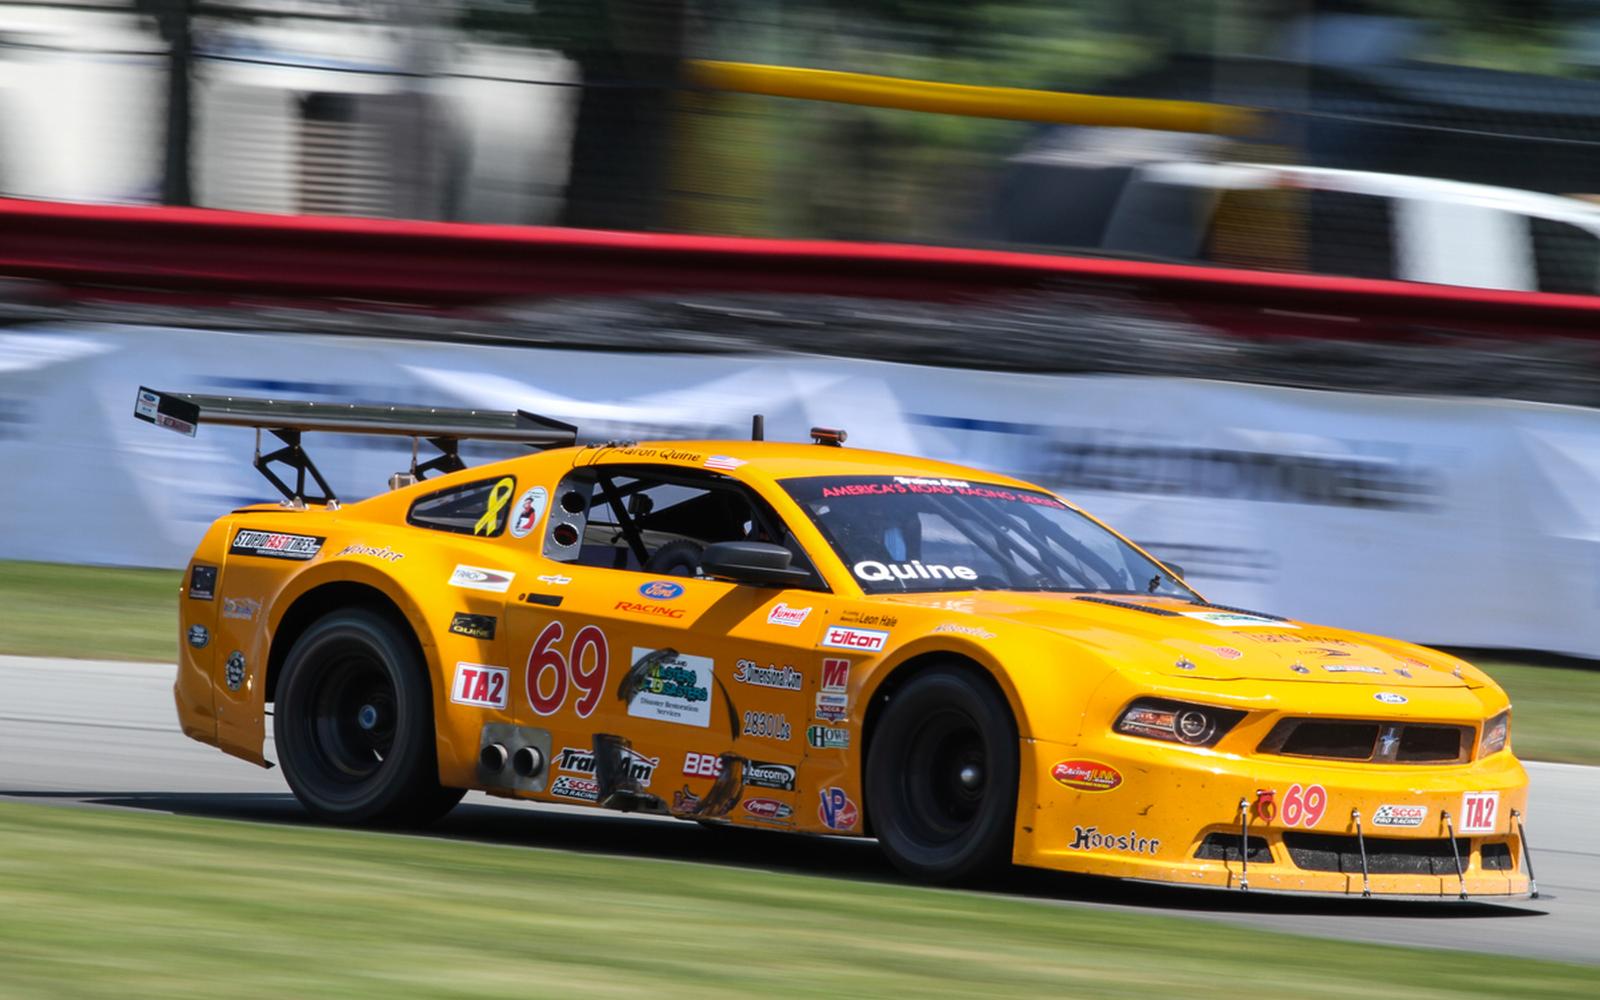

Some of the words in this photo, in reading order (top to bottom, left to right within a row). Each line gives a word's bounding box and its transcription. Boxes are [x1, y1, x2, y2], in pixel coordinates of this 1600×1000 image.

[660, 449, 701, 462] Quine
[822, 484, 907, 497] AMERICA'S
[909, 484, 954, 494] ROAD
[957, 487, 1016, 500] RACING
[854, 560, 978, 581] Quine
[645, 582, 678, 597] Ford
[614, 601, 686, 619] RACING
[829, 629, 881, 648] tilton
[525, 620, 610, 719] 69
[461, 669, 505, 703] TA2
[743, 711, 774, 736] 2830
[553, 787, 570, 796] PRO
[820, 788, 846, 829] VP
[1281, 783, 1328, 828] 69
[1391, 807, 1423, 817] SCCA
[1465, 797, 1496, 828] TA2
[1373, 817, 1391, 825] PRO
[1069, 825, 1160, 854] Hoosier
